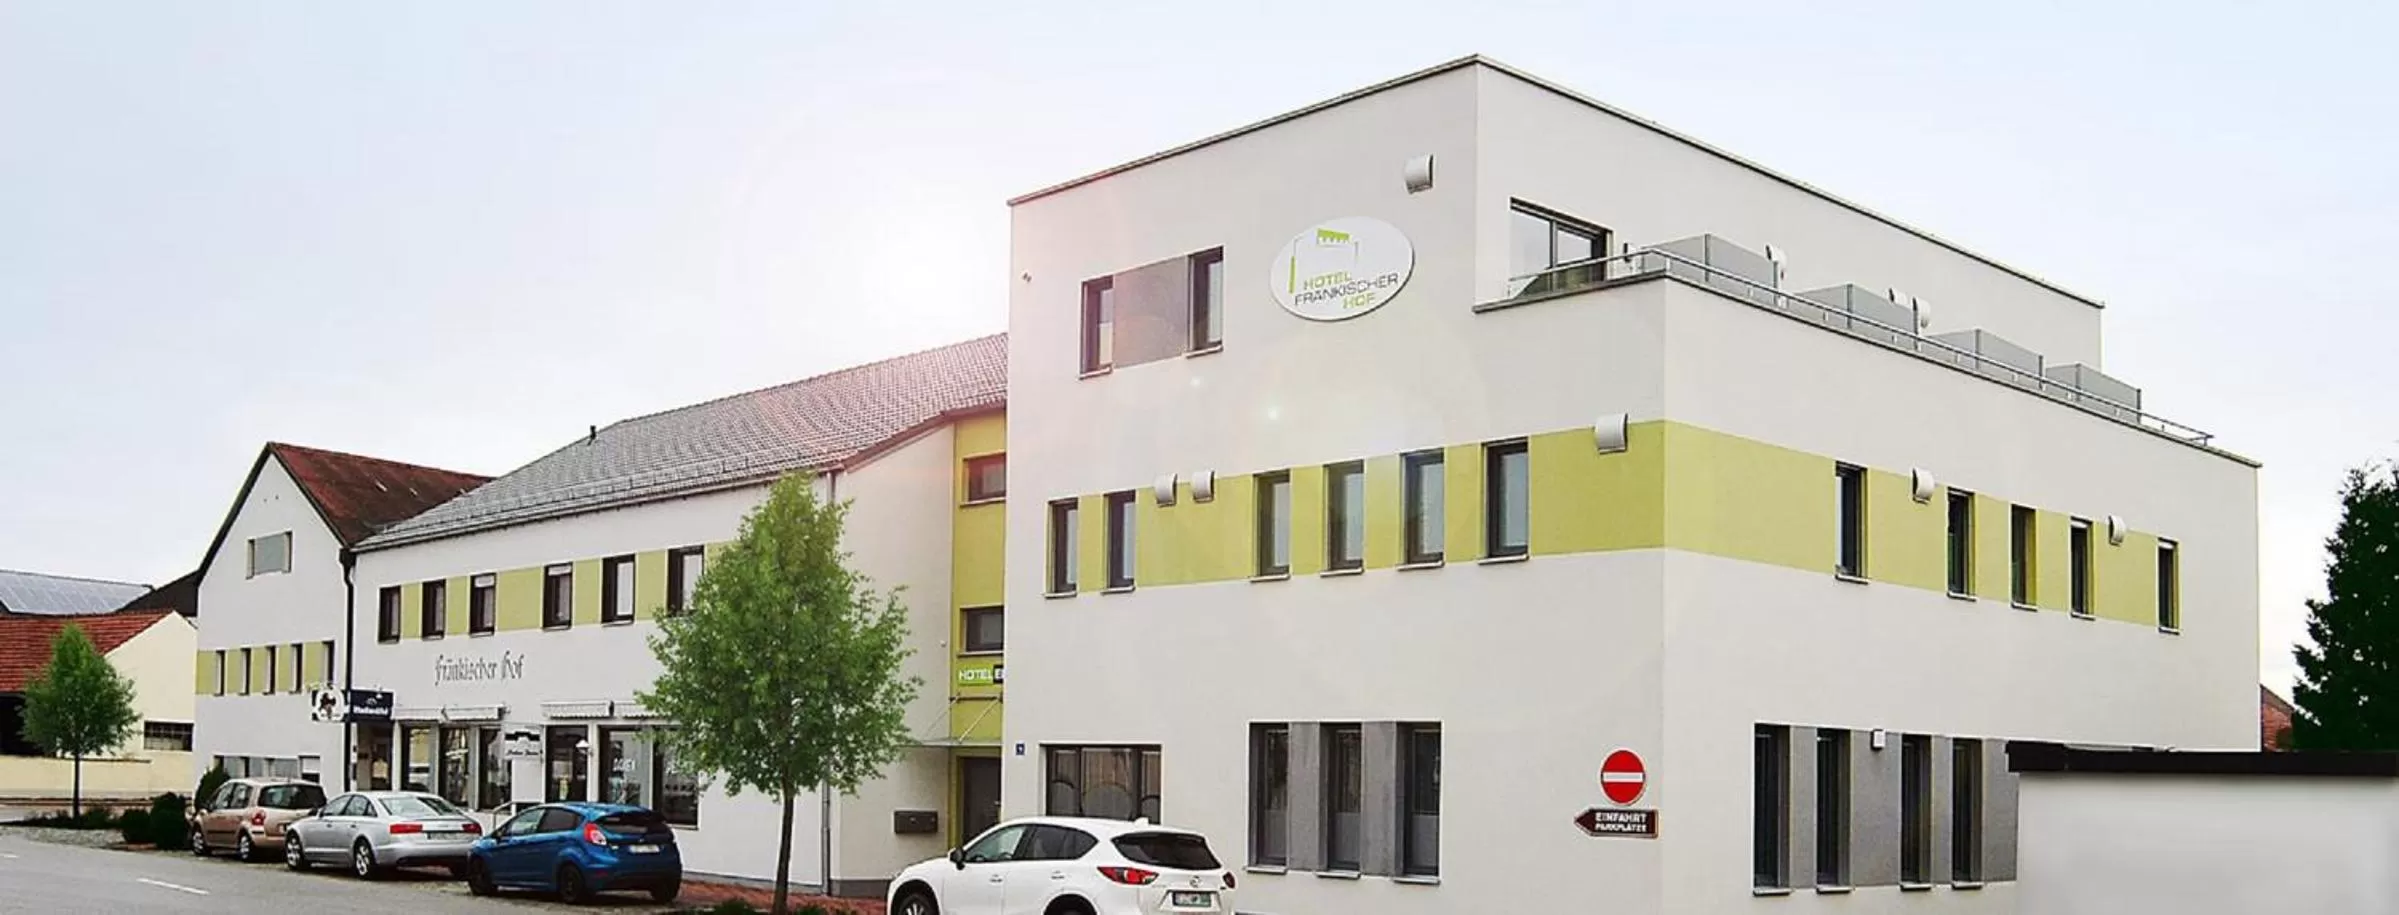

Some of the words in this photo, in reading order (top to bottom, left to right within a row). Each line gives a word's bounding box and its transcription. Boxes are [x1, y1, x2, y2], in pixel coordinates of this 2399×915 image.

[1303, 271, 1352, 290] HOTEL
[1343, 292, 1375, 309] HOF
[959, 668, 993, 681] HOTEL
[1595, 812, 1647, 823] EINFAHRT
